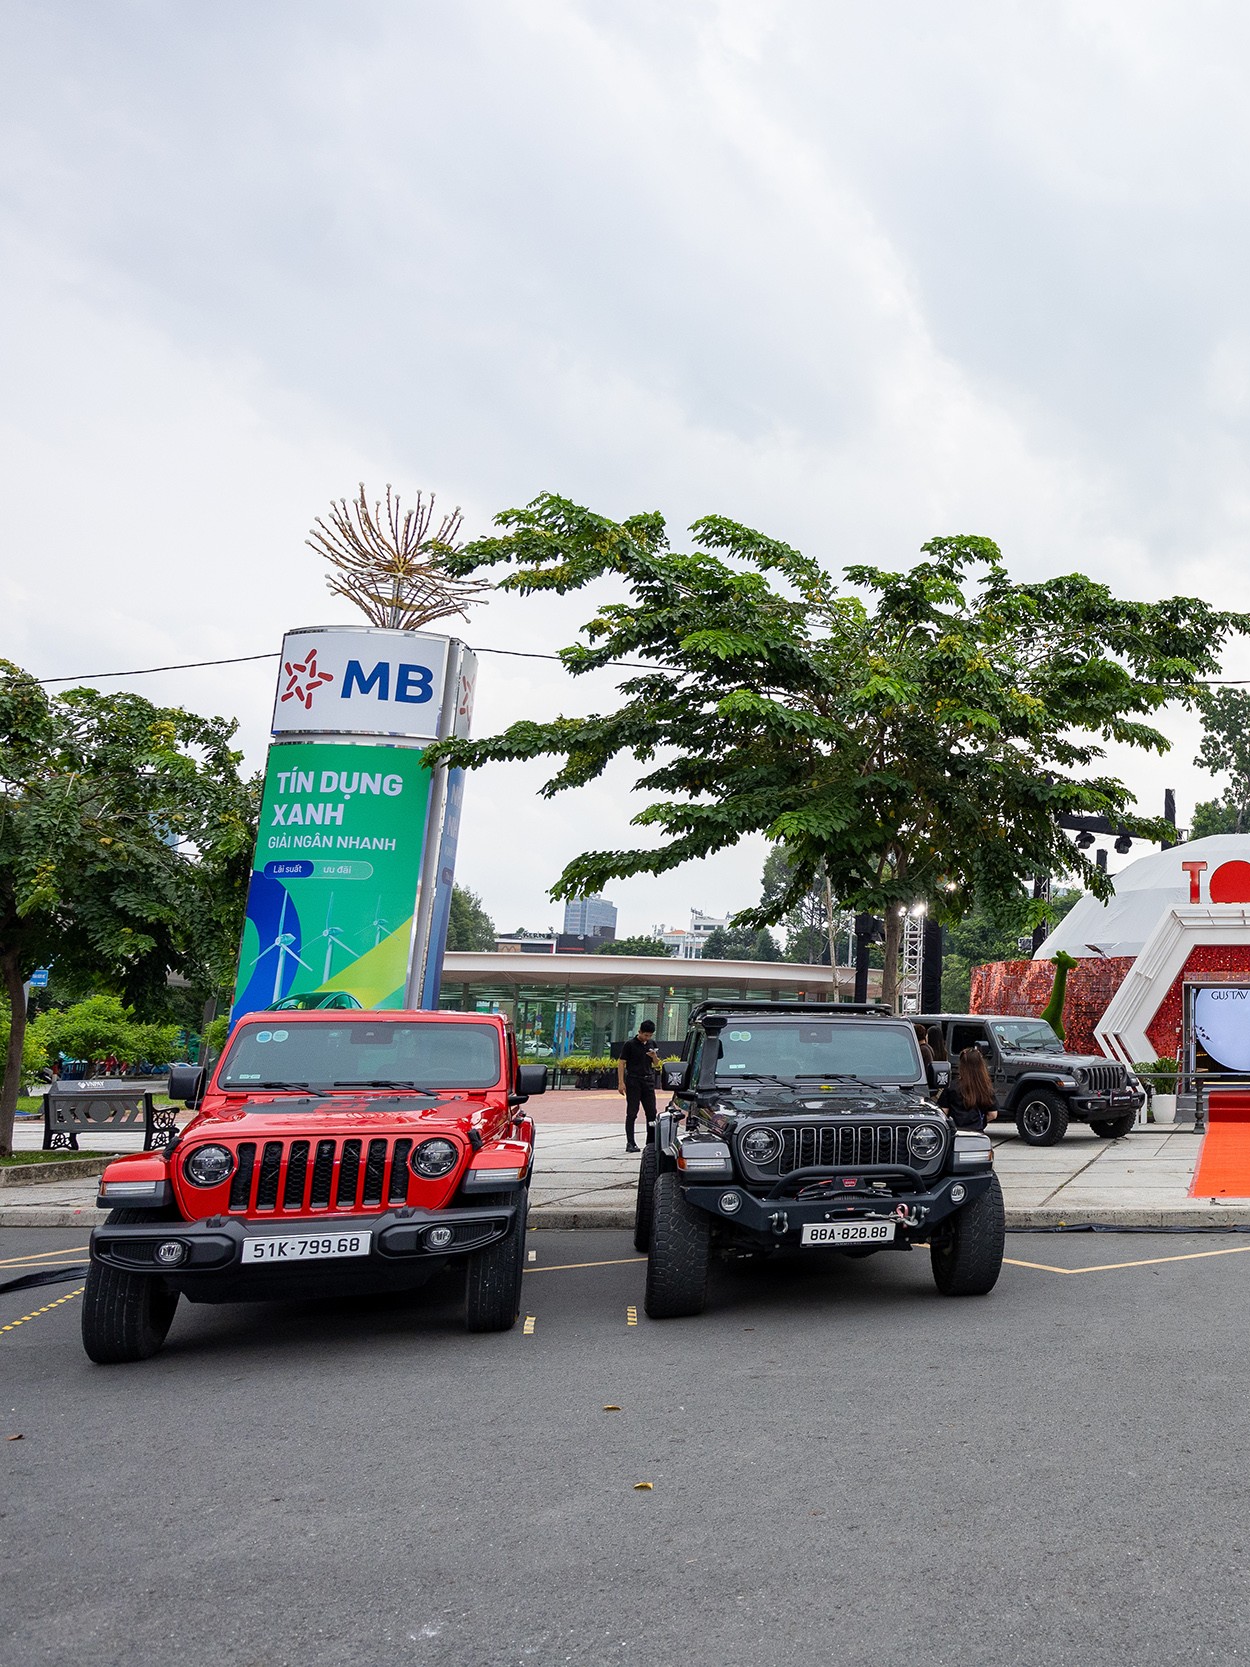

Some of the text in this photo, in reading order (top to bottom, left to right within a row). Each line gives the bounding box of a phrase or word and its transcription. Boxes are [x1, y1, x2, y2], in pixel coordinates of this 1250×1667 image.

[341, 660, 434, 704] MB
[277, 766, 403, 800] TÍN DỤNG
[271, 803, 345, 826] XANH
[268, 832, 397, 851] GIẢI NGÂN NHANH
[286, 863, 302, 873] suất
[1211, 990, 1249, 1001] GUSTAV
[810, 1226, 888, 1241] 88A-828.88
[253, 1237, 360, 1259] 51K-799.68
